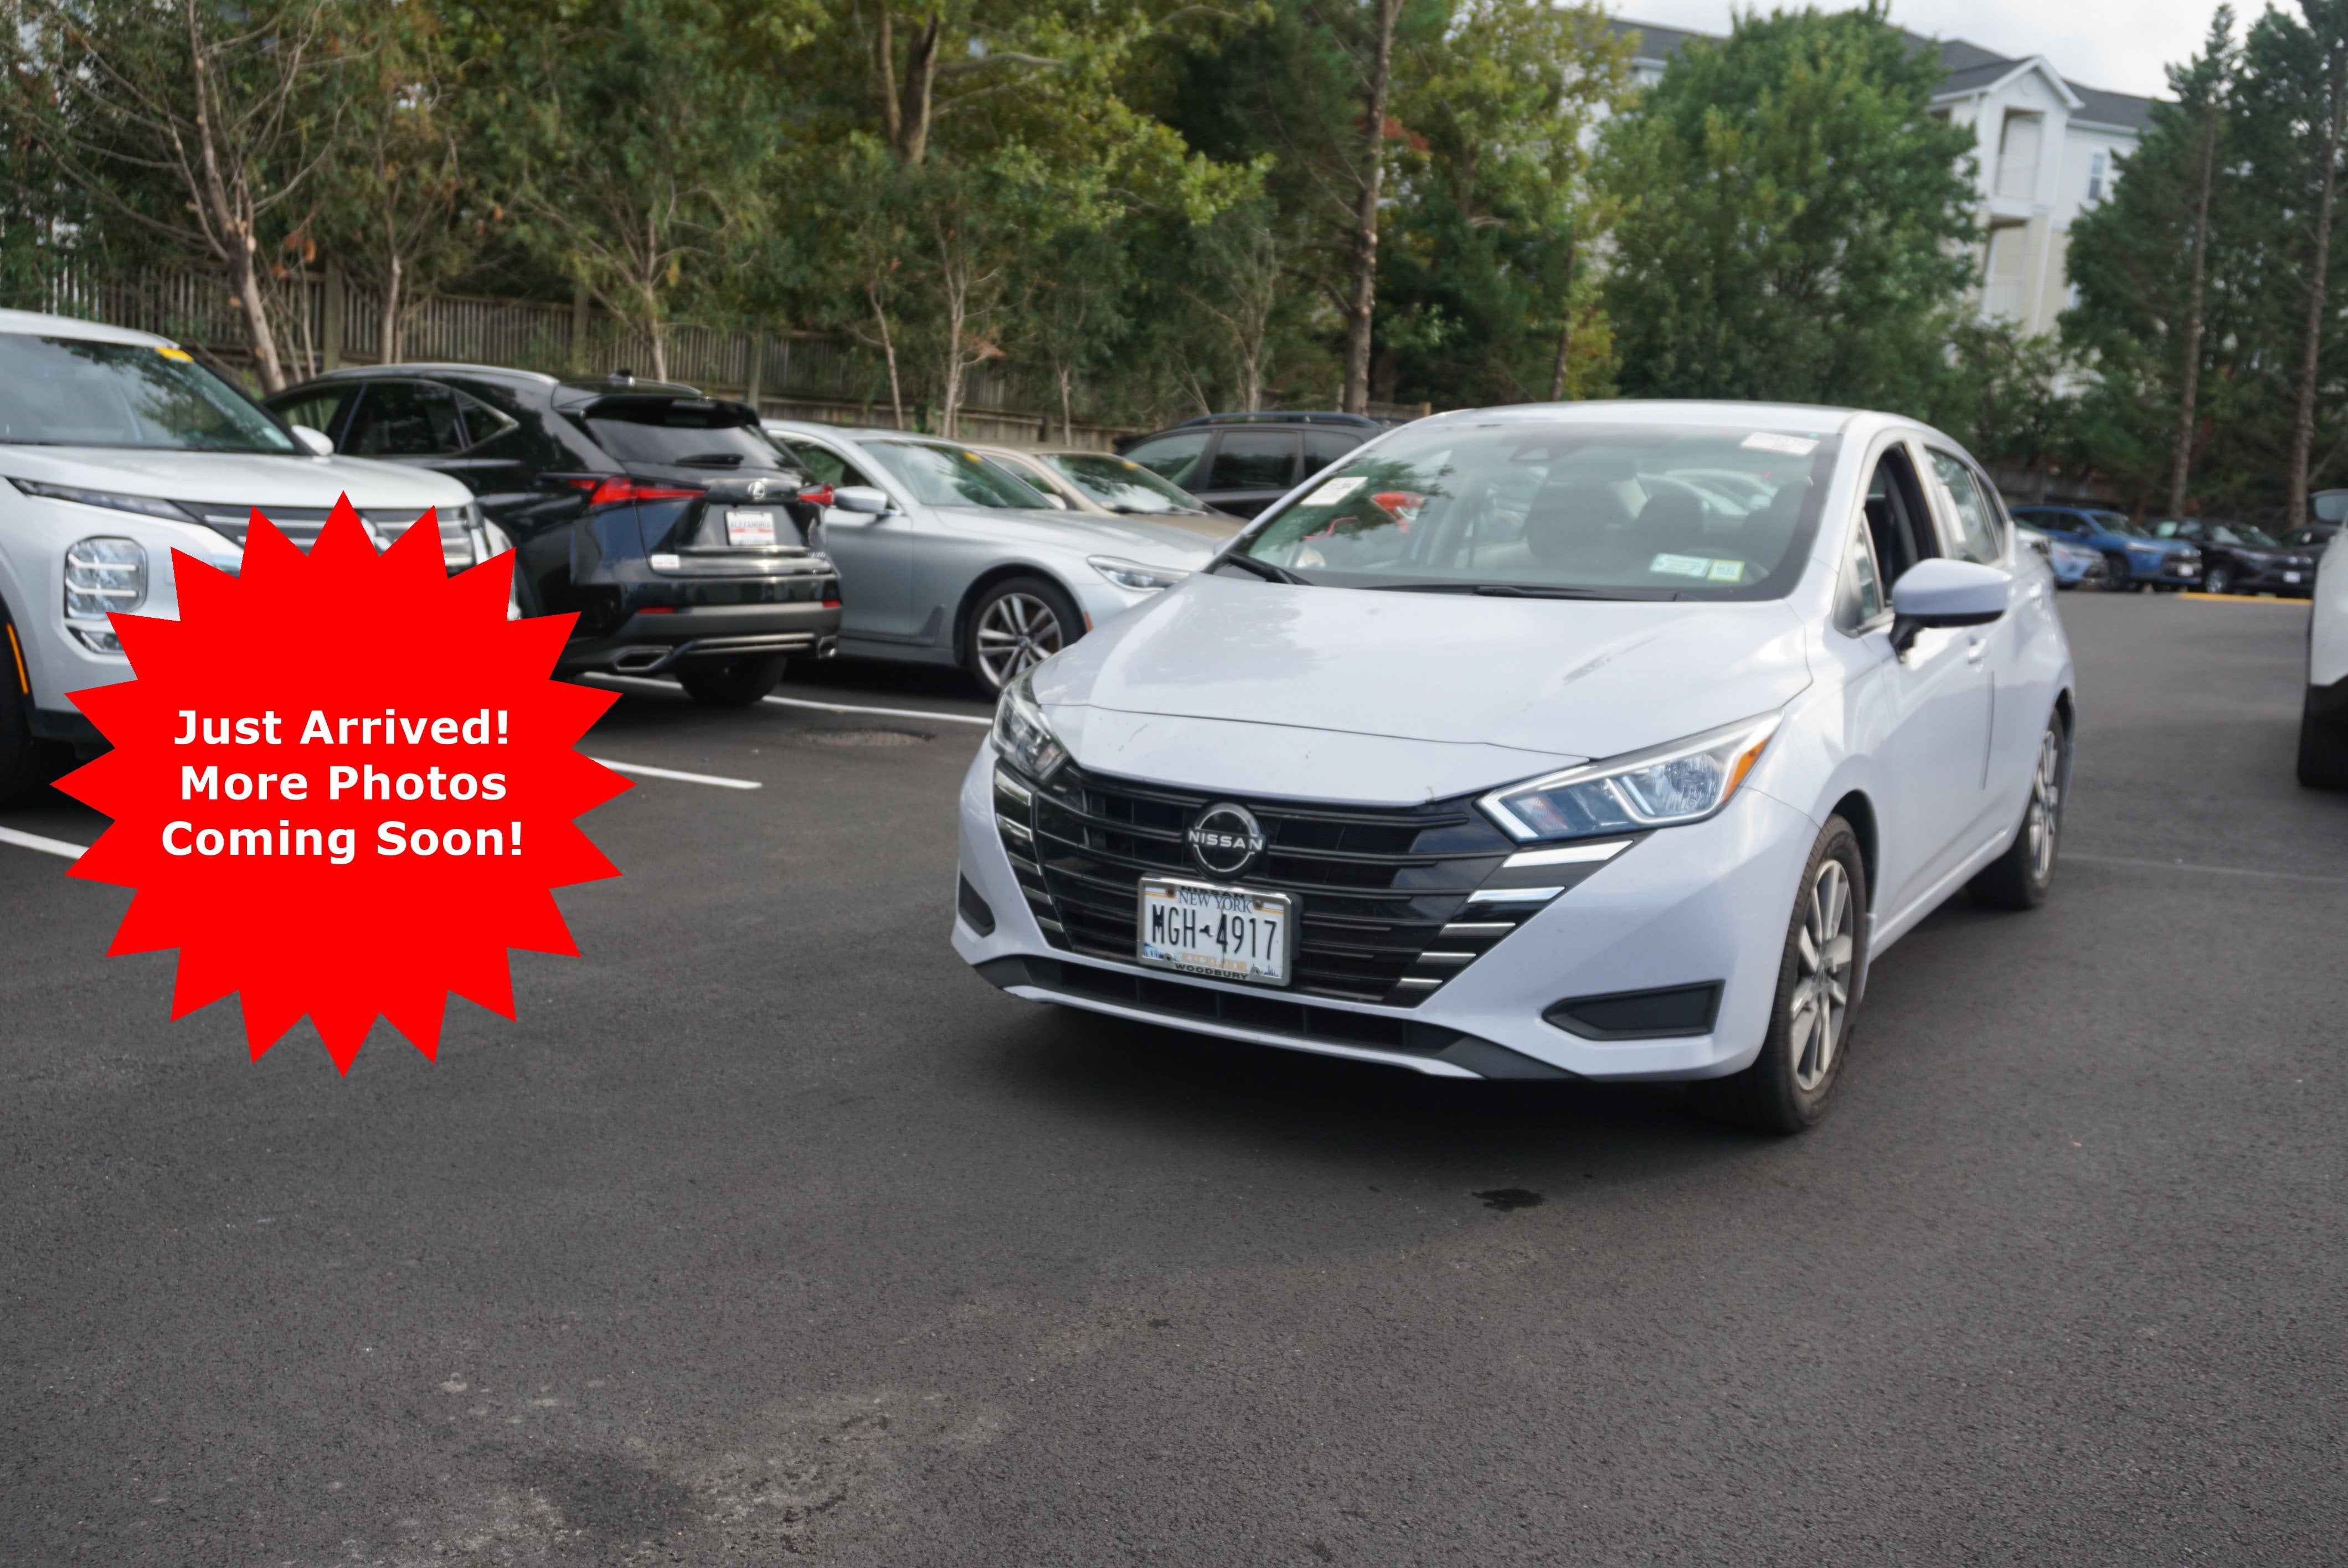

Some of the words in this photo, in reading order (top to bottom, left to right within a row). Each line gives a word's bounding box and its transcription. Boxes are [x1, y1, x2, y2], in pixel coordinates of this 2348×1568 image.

[1188, 831, 1263, 850] NISSAN
[1178, 890, 1211, 908] NEW
[1214, 895, 1253, 914] YORK
[1181, 886, 1245, 899] NISSAN
[1152, 904, 1196, 949] MGH
[1216, 913, 1278, 961] 4917
[1175, 963, 1249, 980] WOODBURY
